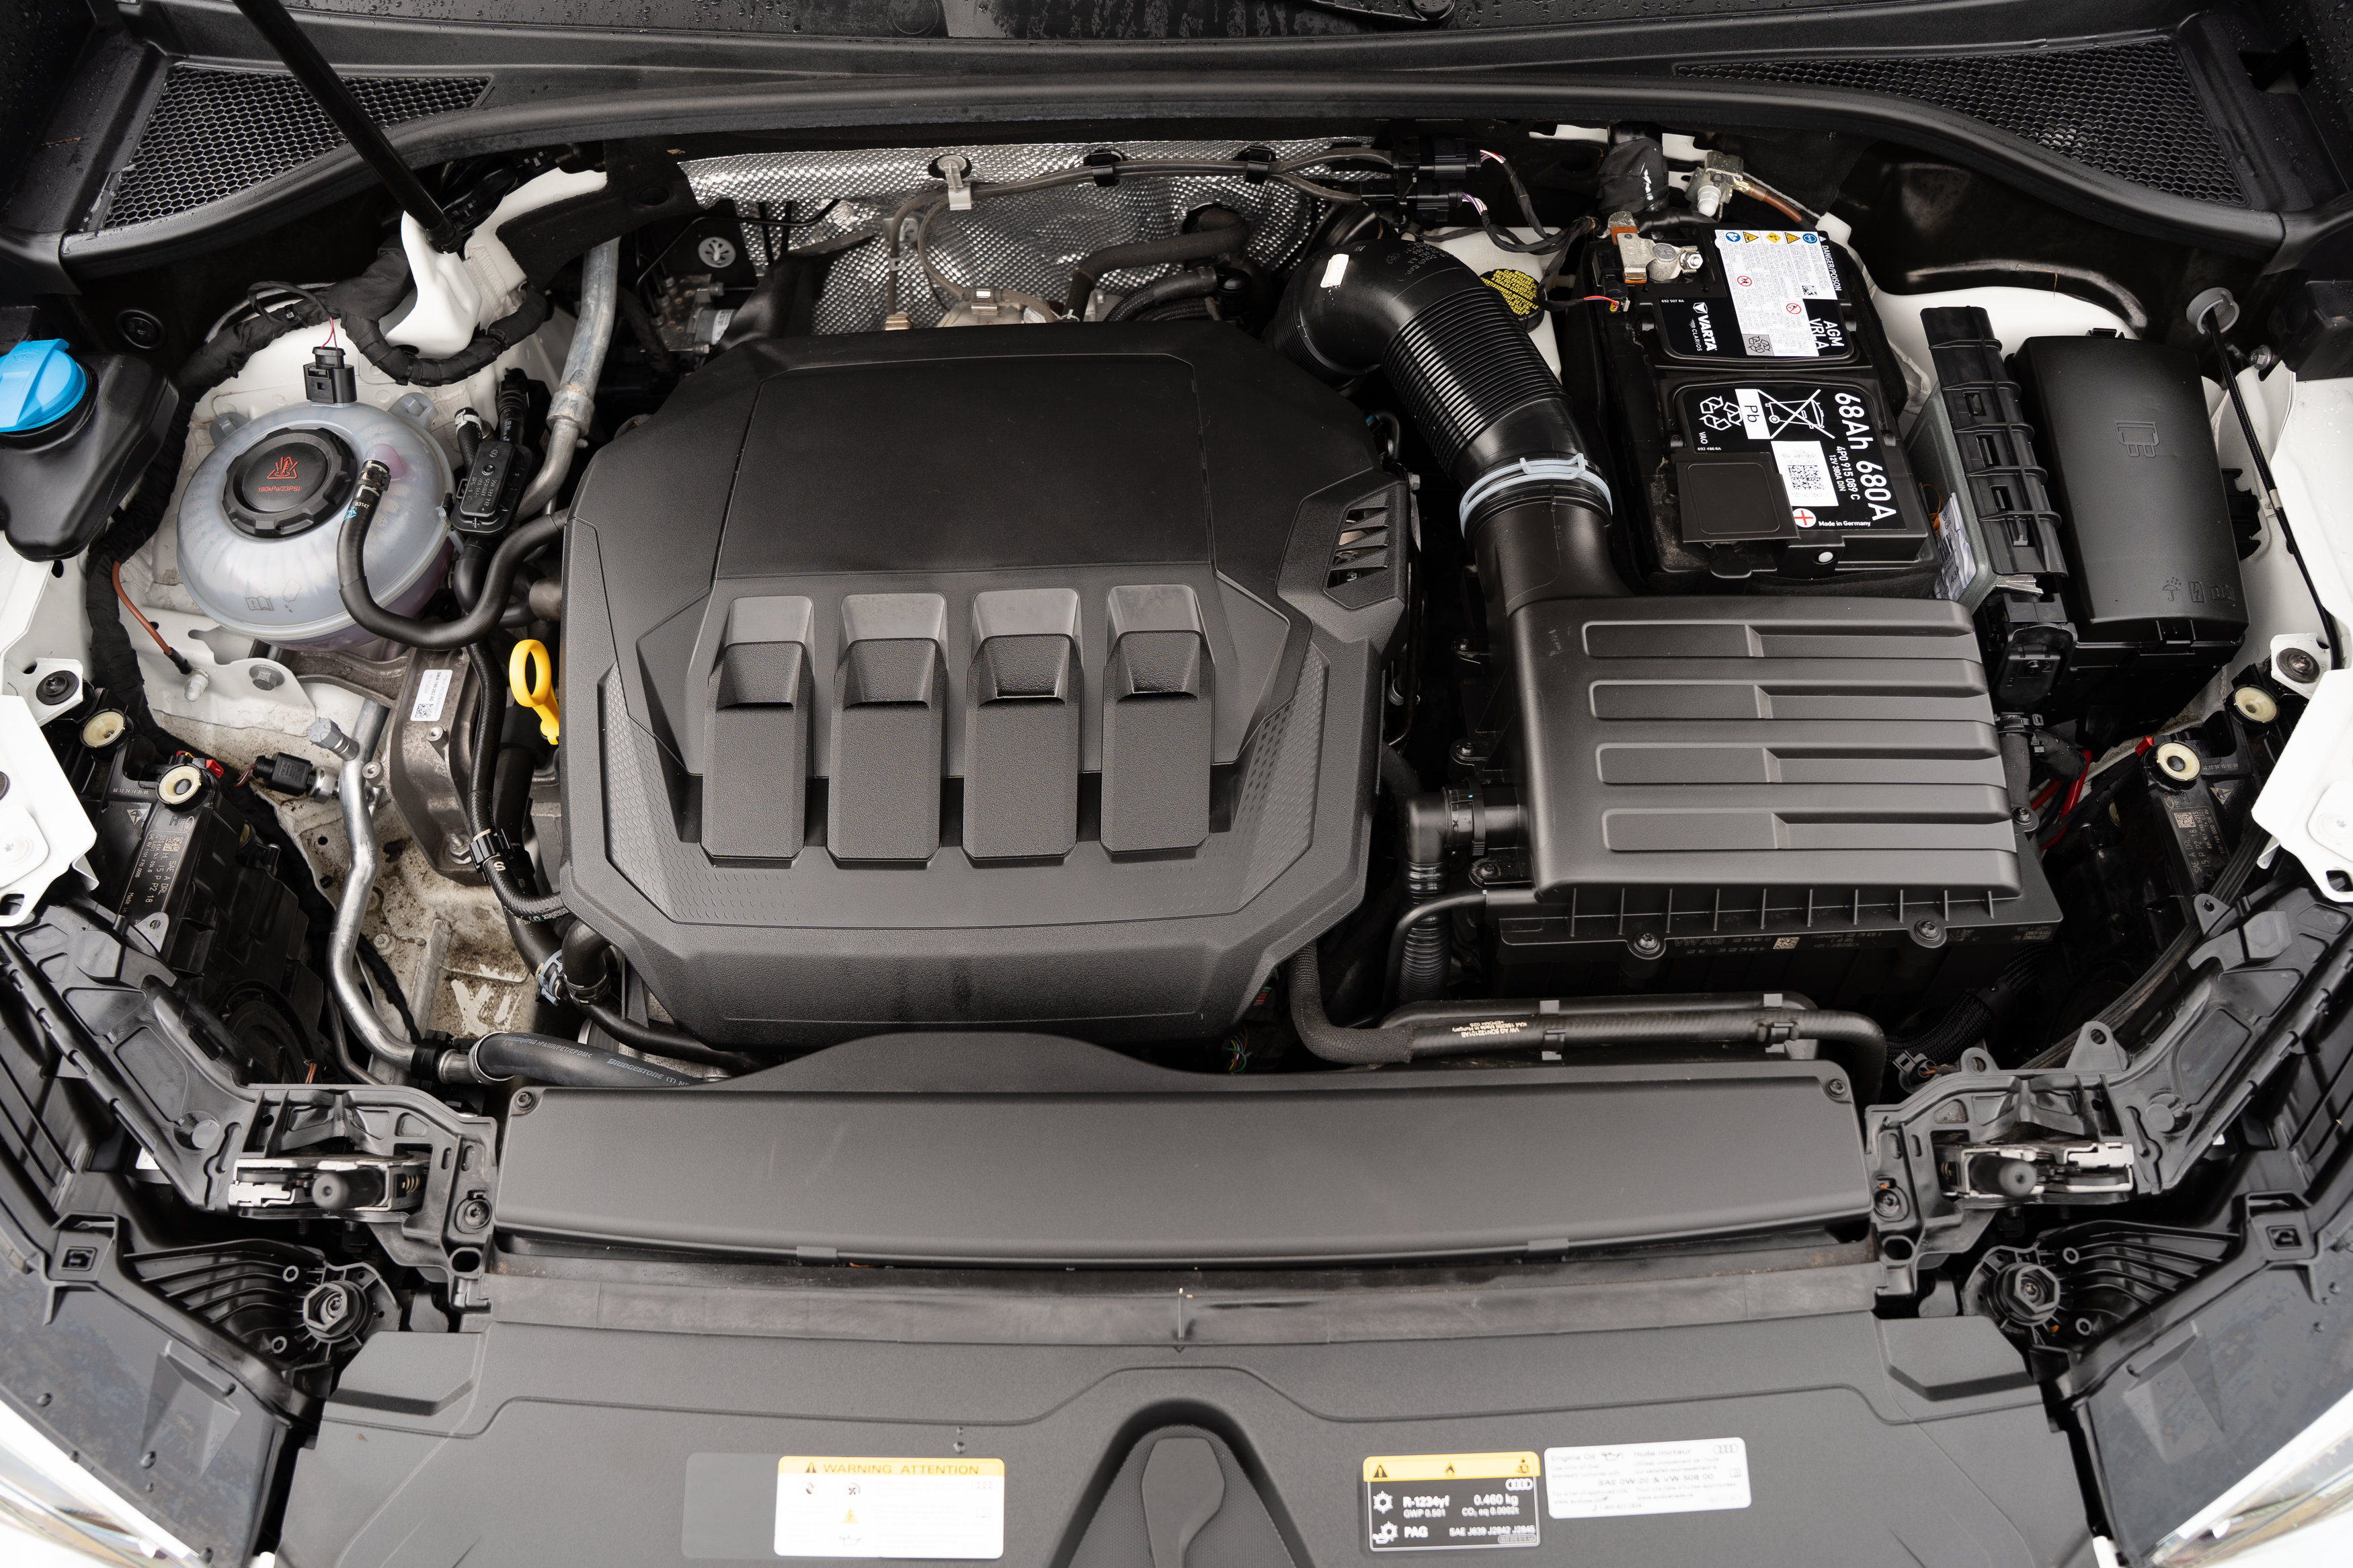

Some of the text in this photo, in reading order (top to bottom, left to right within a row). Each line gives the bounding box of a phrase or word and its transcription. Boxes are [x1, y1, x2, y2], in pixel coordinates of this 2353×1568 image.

[1821, 245, 1843, 292] DANGER/POISON
[1696, 315, 1718, 352] VARTA
[1808, 317, 1830, 349] VRLA
[1823, 319, 1845, 347] AGM
[1691, 328, 1702, 352] CLARIOS
[1745, 405, 1758, 423] Pb
[1698, 431, 1709, 445] VAO
[1834, 392, 1897, 521] 68Ah 680A
[1829, 454, 1847, 491] 12V 380A DIN
[1841, 462, 1853, 477] 915
[1845, 478, 1858, 492] 089
[1845, 520, 1871, 528] Germany
[2188, 828, 2199, 837] 18
[2182, 837, 2194, 850] DRL
[2193, 839, 2204, 850] P2
[165, 860, 177, 872] SAE
[493, 861, 506, 872] S
[2190, 860, 2202, 873] SAE
[148, 882, 159, 891] P2
[157, 882, 169, 895] DRL
[124, 891, 134, 904] Made
[144, 894, 155, 903] 18
[607, 1058, 664, 1080] BRIDGESTONE
[1550, 1452, 1596, 1463] Engine Oil
[1632, 1447, 1692, 1458] Huile moteur
[822, 1462, 980, 1475] WARNING ATTENTION
[1473, 1493, 1504, 1506] 0.460
[1505, 1492, 1519, 1506] kg
